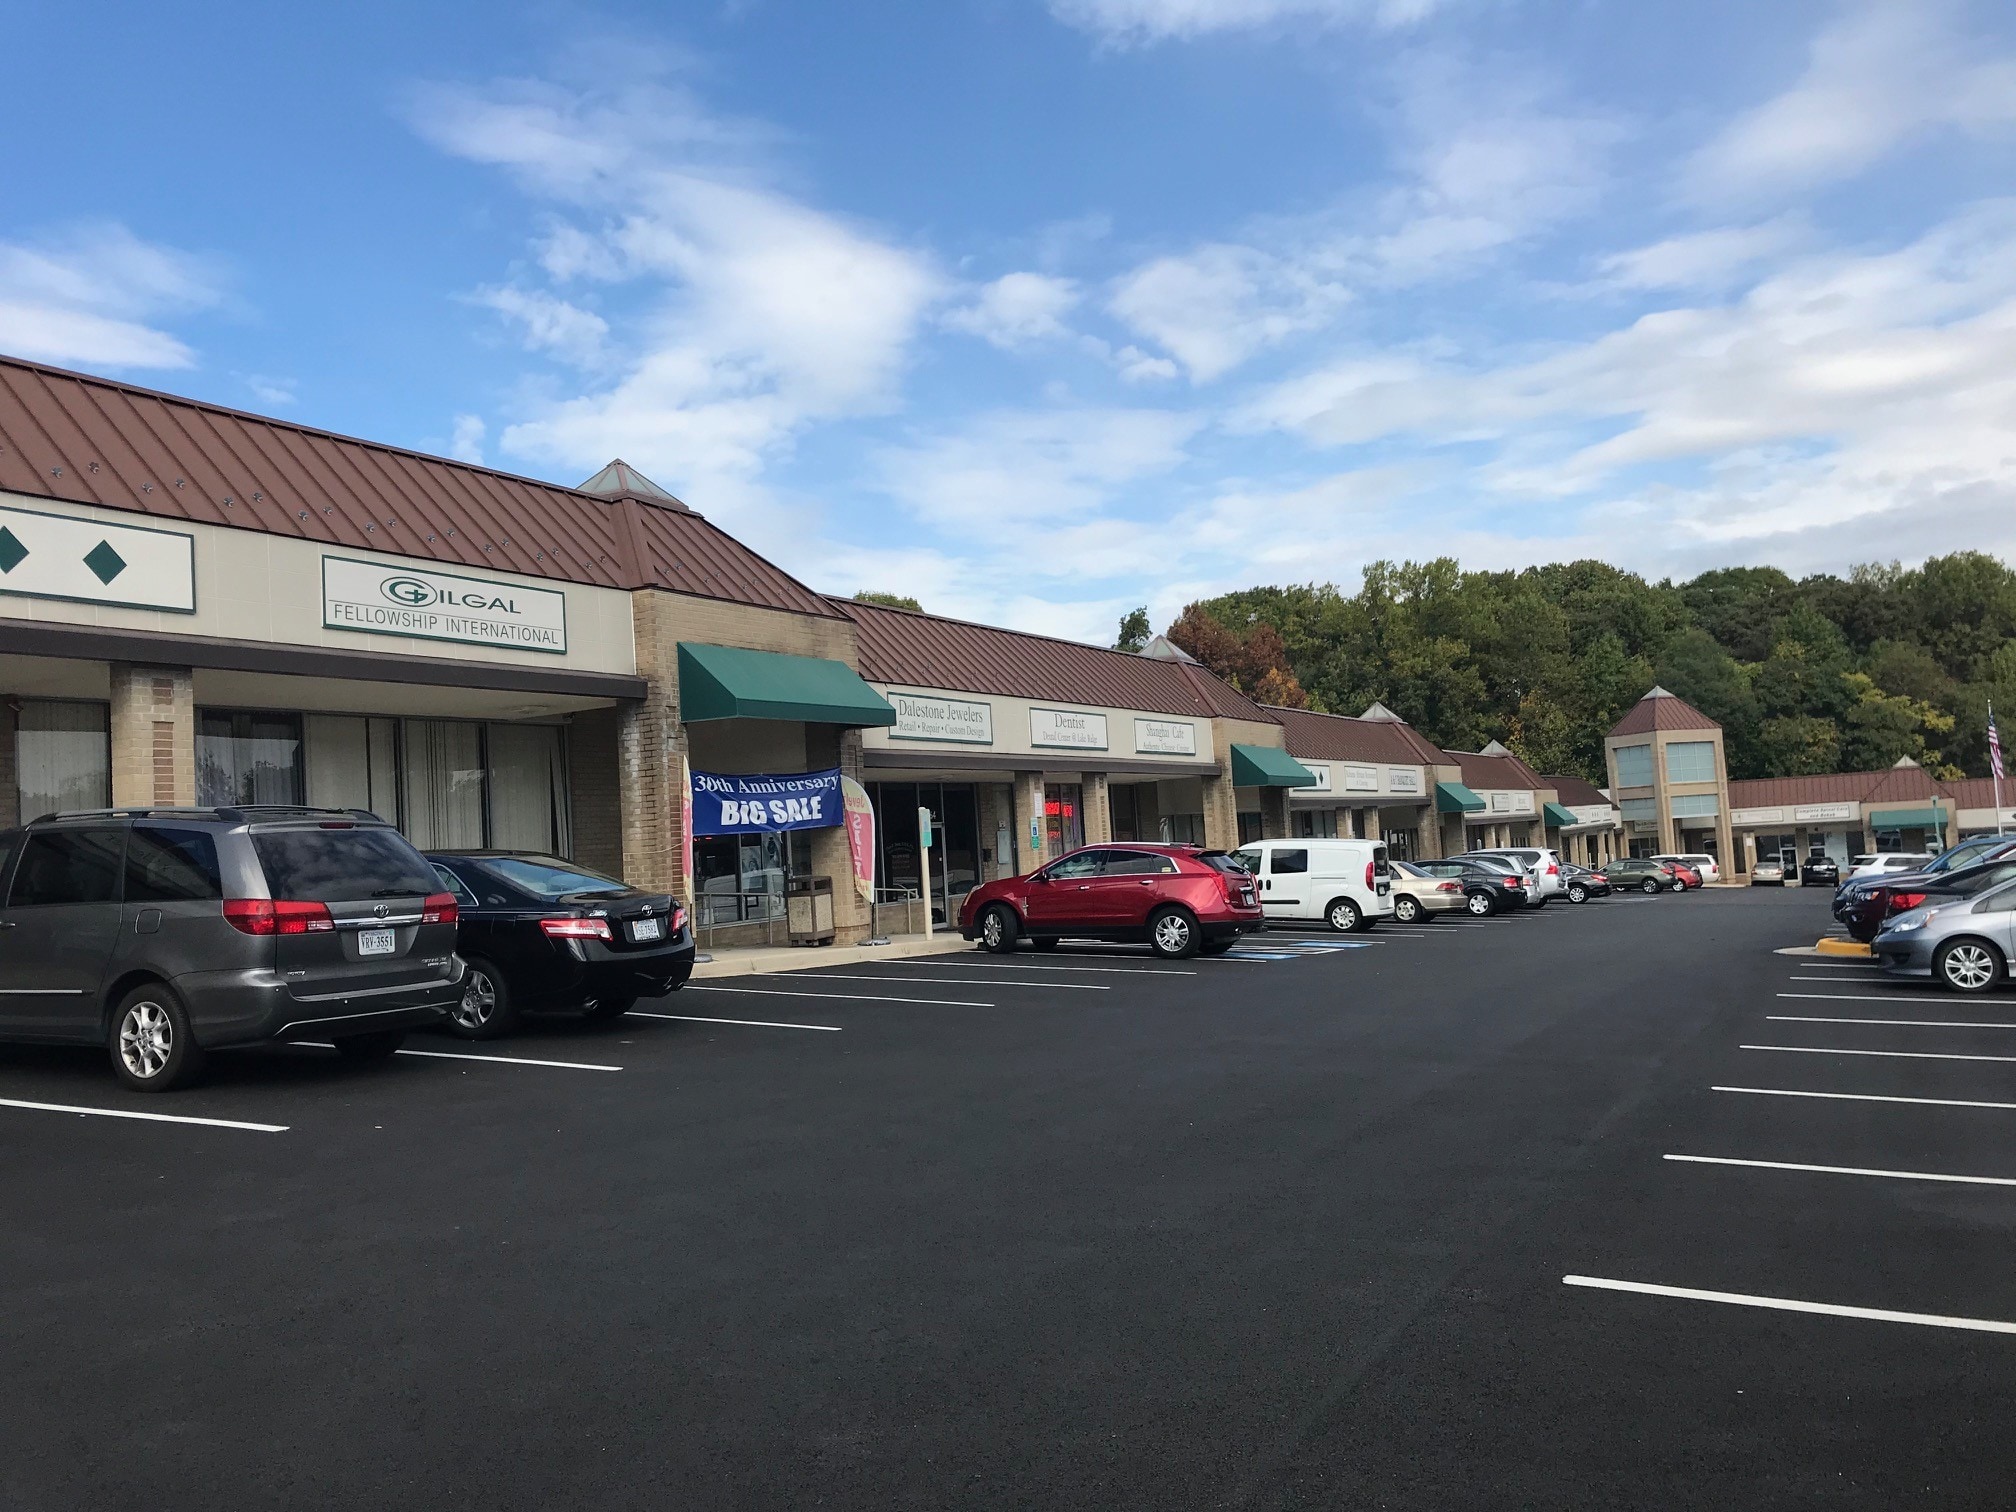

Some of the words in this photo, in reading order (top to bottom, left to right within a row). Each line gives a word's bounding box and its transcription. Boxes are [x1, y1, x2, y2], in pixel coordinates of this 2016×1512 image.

[388, 580, 522, 614] GILGAL
[334, 603, 438, 630] FELLOWSHIP
[445, 617, 559, 645] INTERNATIONAL
[898, 699, 945, 720] Dalestone
[946, 704, 983, 723] Jewelers
[1054, 713, 1085, 729] Dentist
[898, 720, 917, 732] Retail
[921, 722, 941, 736] Repair
[944, 724, 966, 736] Custom
[694, 775, 735, 793] 30th
[738, 774, 839, 794] Anniversary
[768, 795, 823, 825] SALE
